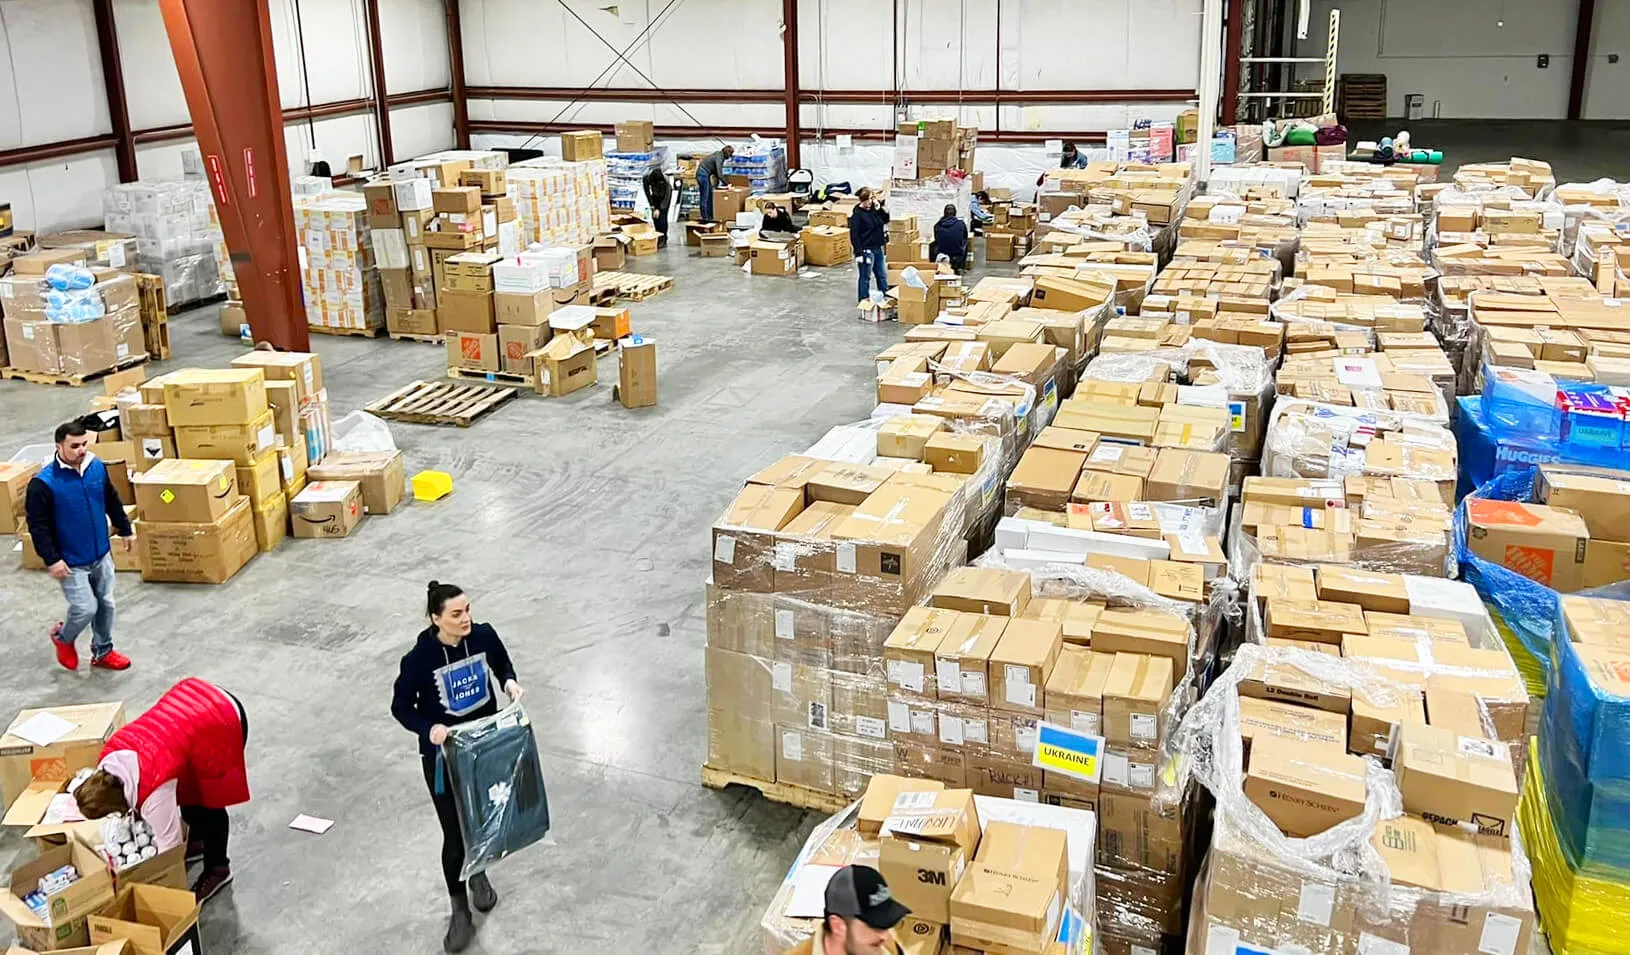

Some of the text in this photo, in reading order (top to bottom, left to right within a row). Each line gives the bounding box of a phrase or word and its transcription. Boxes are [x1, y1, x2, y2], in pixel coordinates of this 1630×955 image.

[1496, 446, 1560, 464] HUGGIES
[1044, 747, 1089, 766] UKRAINE
[1277, 791, 1304, 805] HENRY
[917, 868, 946, 886] 3M
